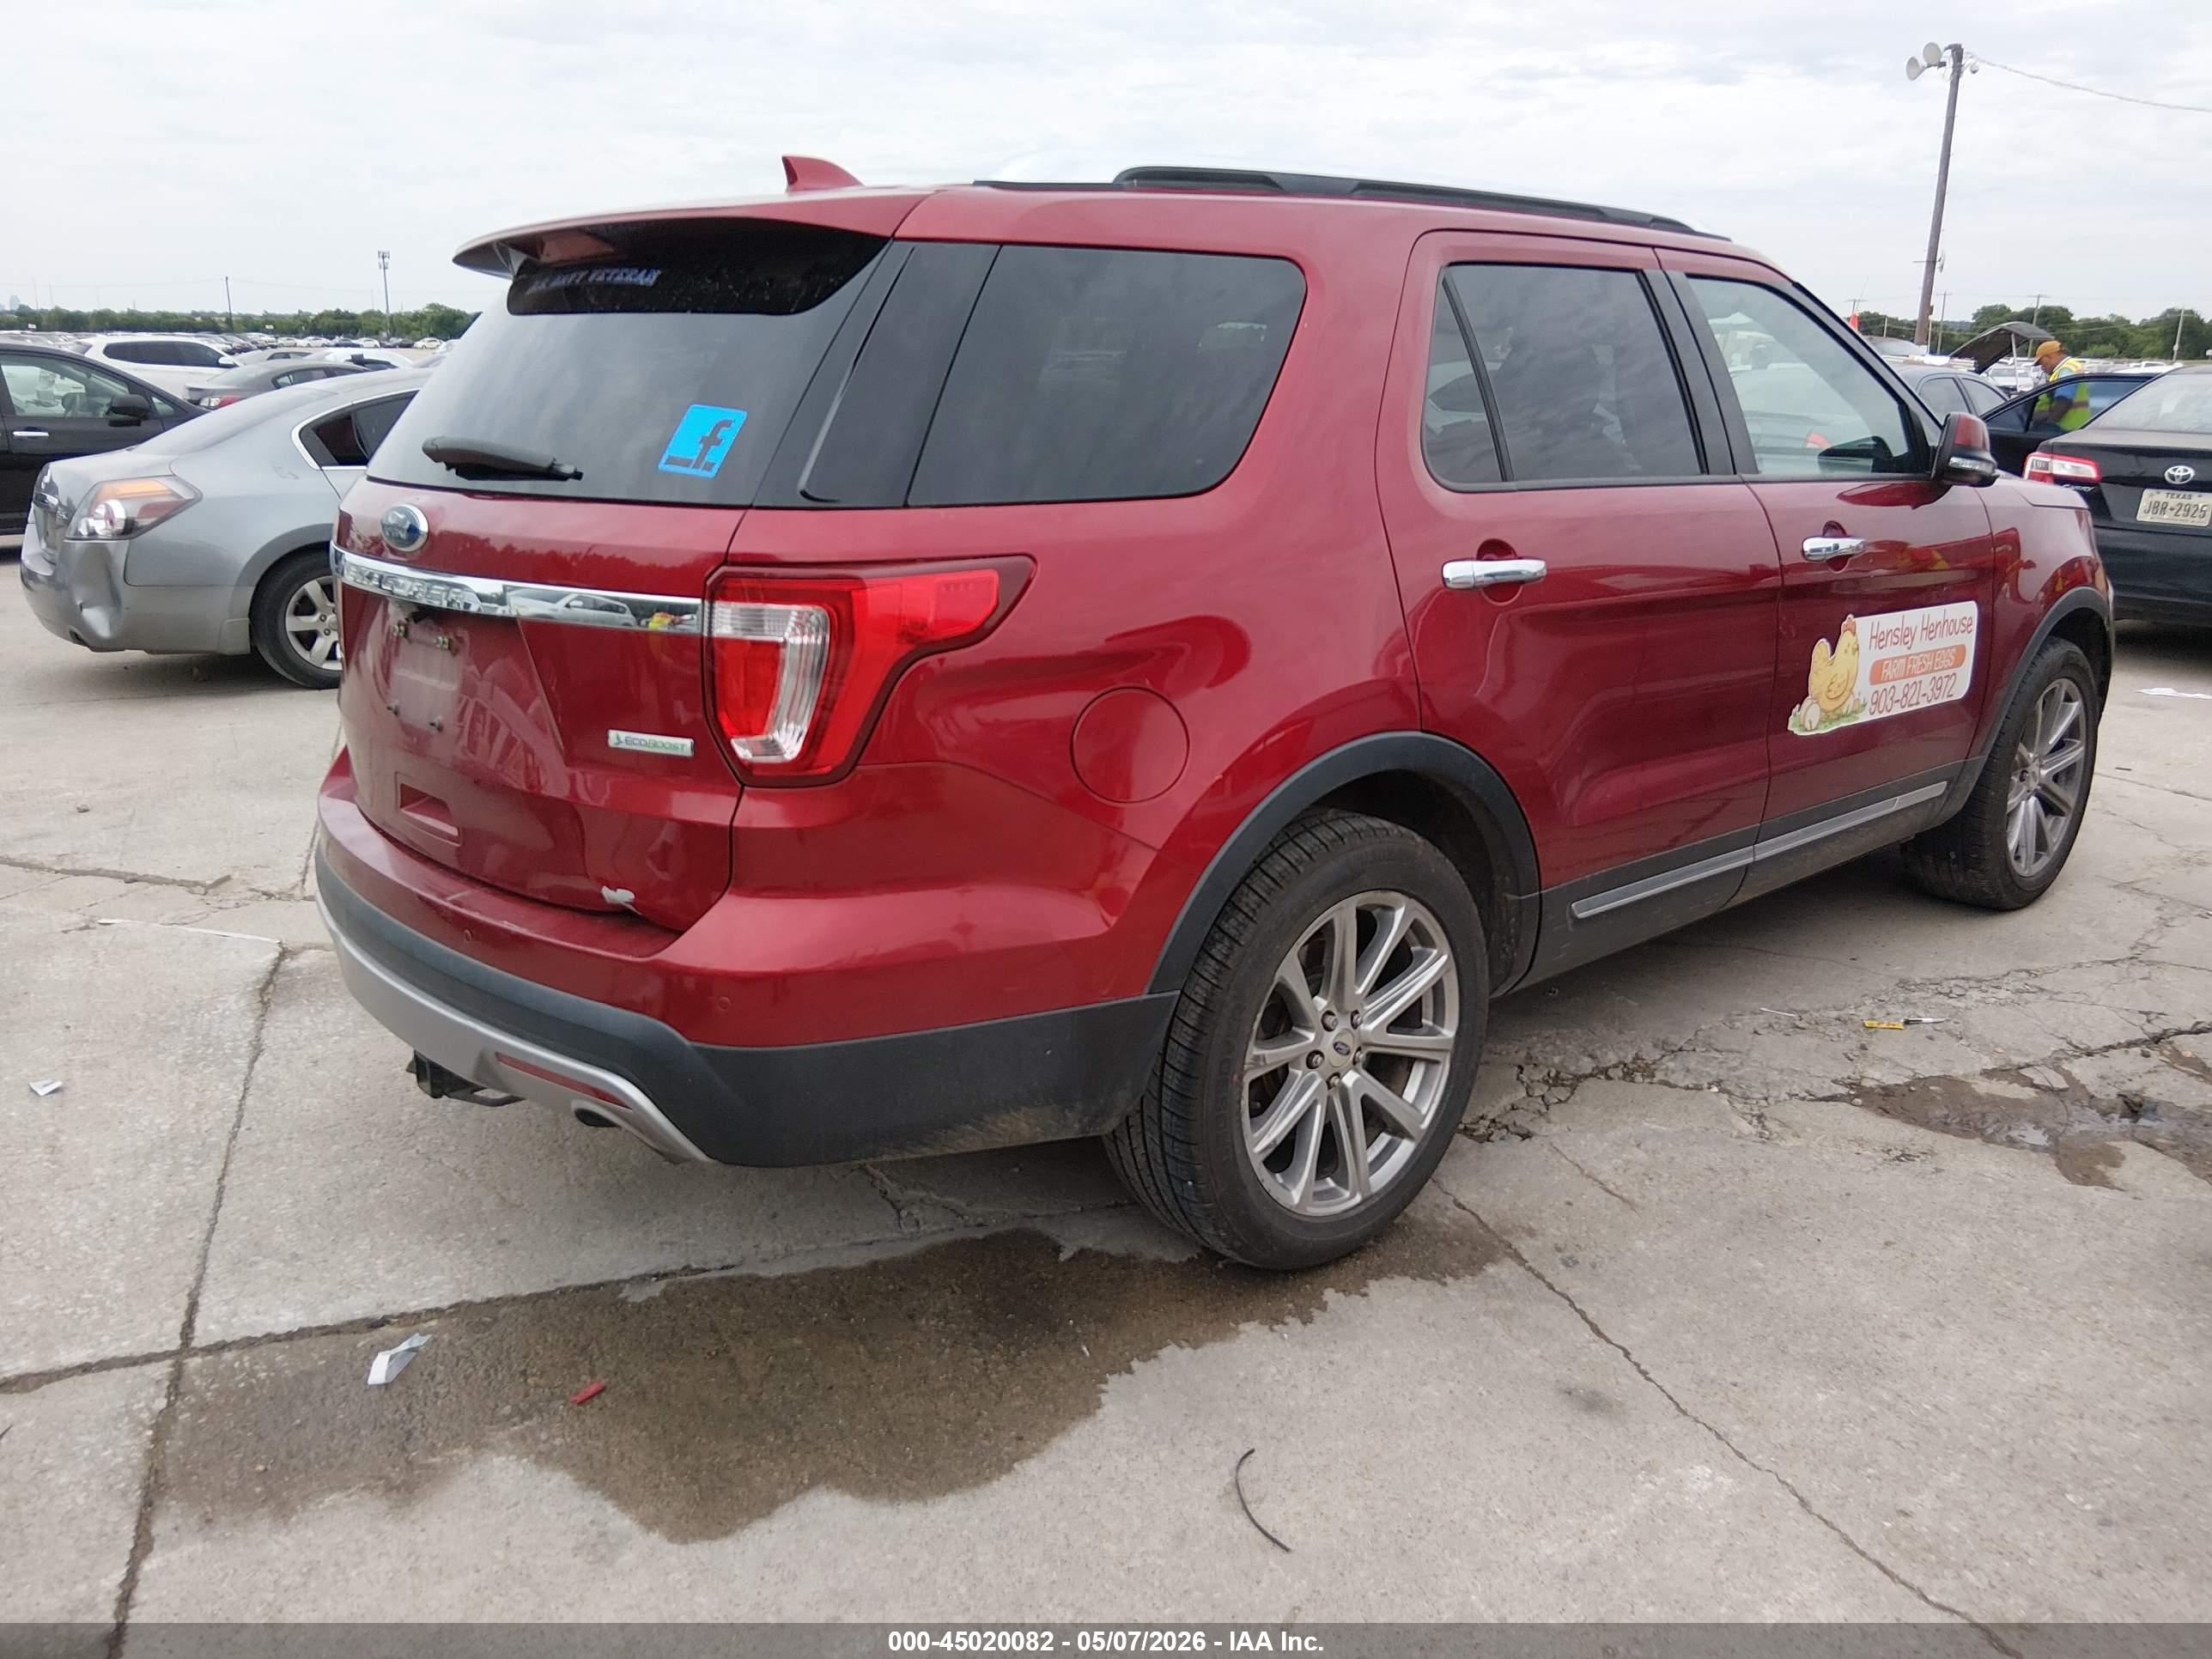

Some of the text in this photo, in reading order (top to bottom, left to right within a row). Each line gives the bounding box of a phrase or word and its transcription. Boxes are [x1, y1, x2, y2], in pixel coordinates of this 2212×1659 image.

[1869, 608, 1973, 650] Hensley Henhouse
[1881, 647, 1956, 681] FARM FRESH EGGS
[1869, 672, 1957, 715] 903-821-3972
